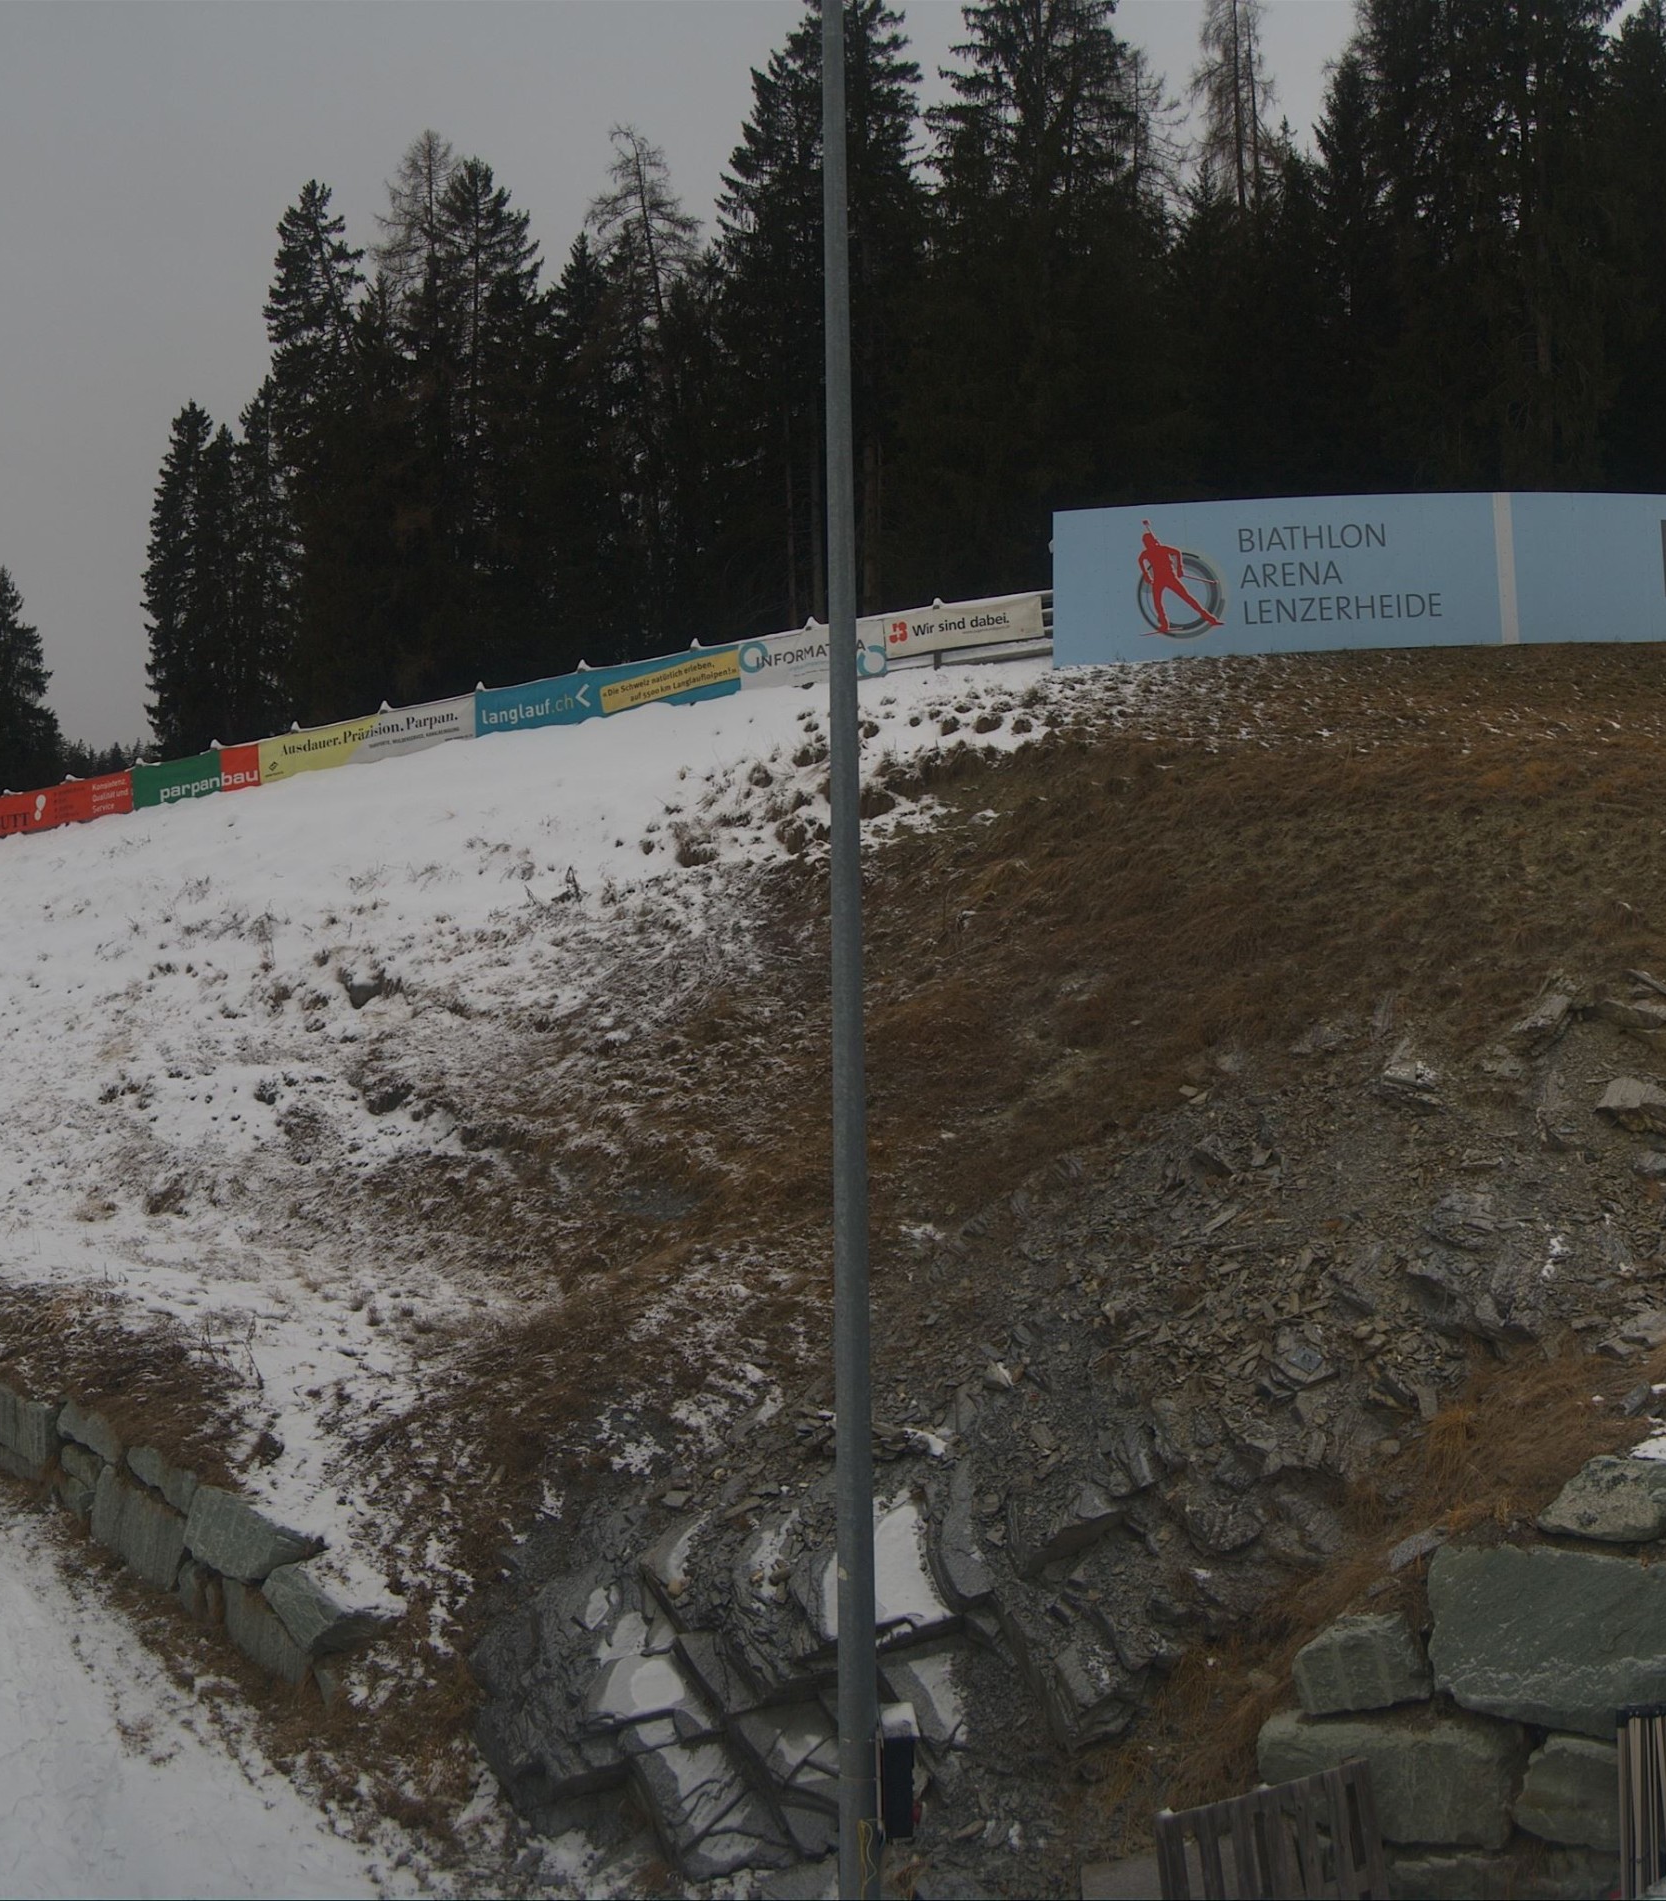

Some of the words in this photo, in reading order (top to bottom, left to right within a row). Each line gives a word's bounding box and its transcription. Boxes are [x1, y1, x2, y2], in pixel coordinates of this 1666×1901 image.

[1238, 523, 1386, 552] BIATHLON
[1240, 560, 1343, 588] ARENA
[1244, 593, 1442, 624] LENZERHEIDE
[912, 623, 934, 636] Wir
[938, 617, 965, 632] sind
[970, 612, 1010, 628] dabei.
[756, 639, 866, 669] INFORMAA
[621, 679, 650, 693] Schweiz
[651, 669, 683, 684] natürlich
[630, 692, 641, 702] auf
[643, 687, 659, 700] 5500
[661, 683, 671, 693] km
[482, 694, 574, 724] langlauf.ch
[280, 735, 342, 757] Ausdauer.
[342, 722, 404, 745] Präzision.
[406, 711, 458, 731] Parpan.
[116, 788, 129, 796] und
[160, 768, 258, 803] parpanbau
[92, 803, 115, 813] Service
